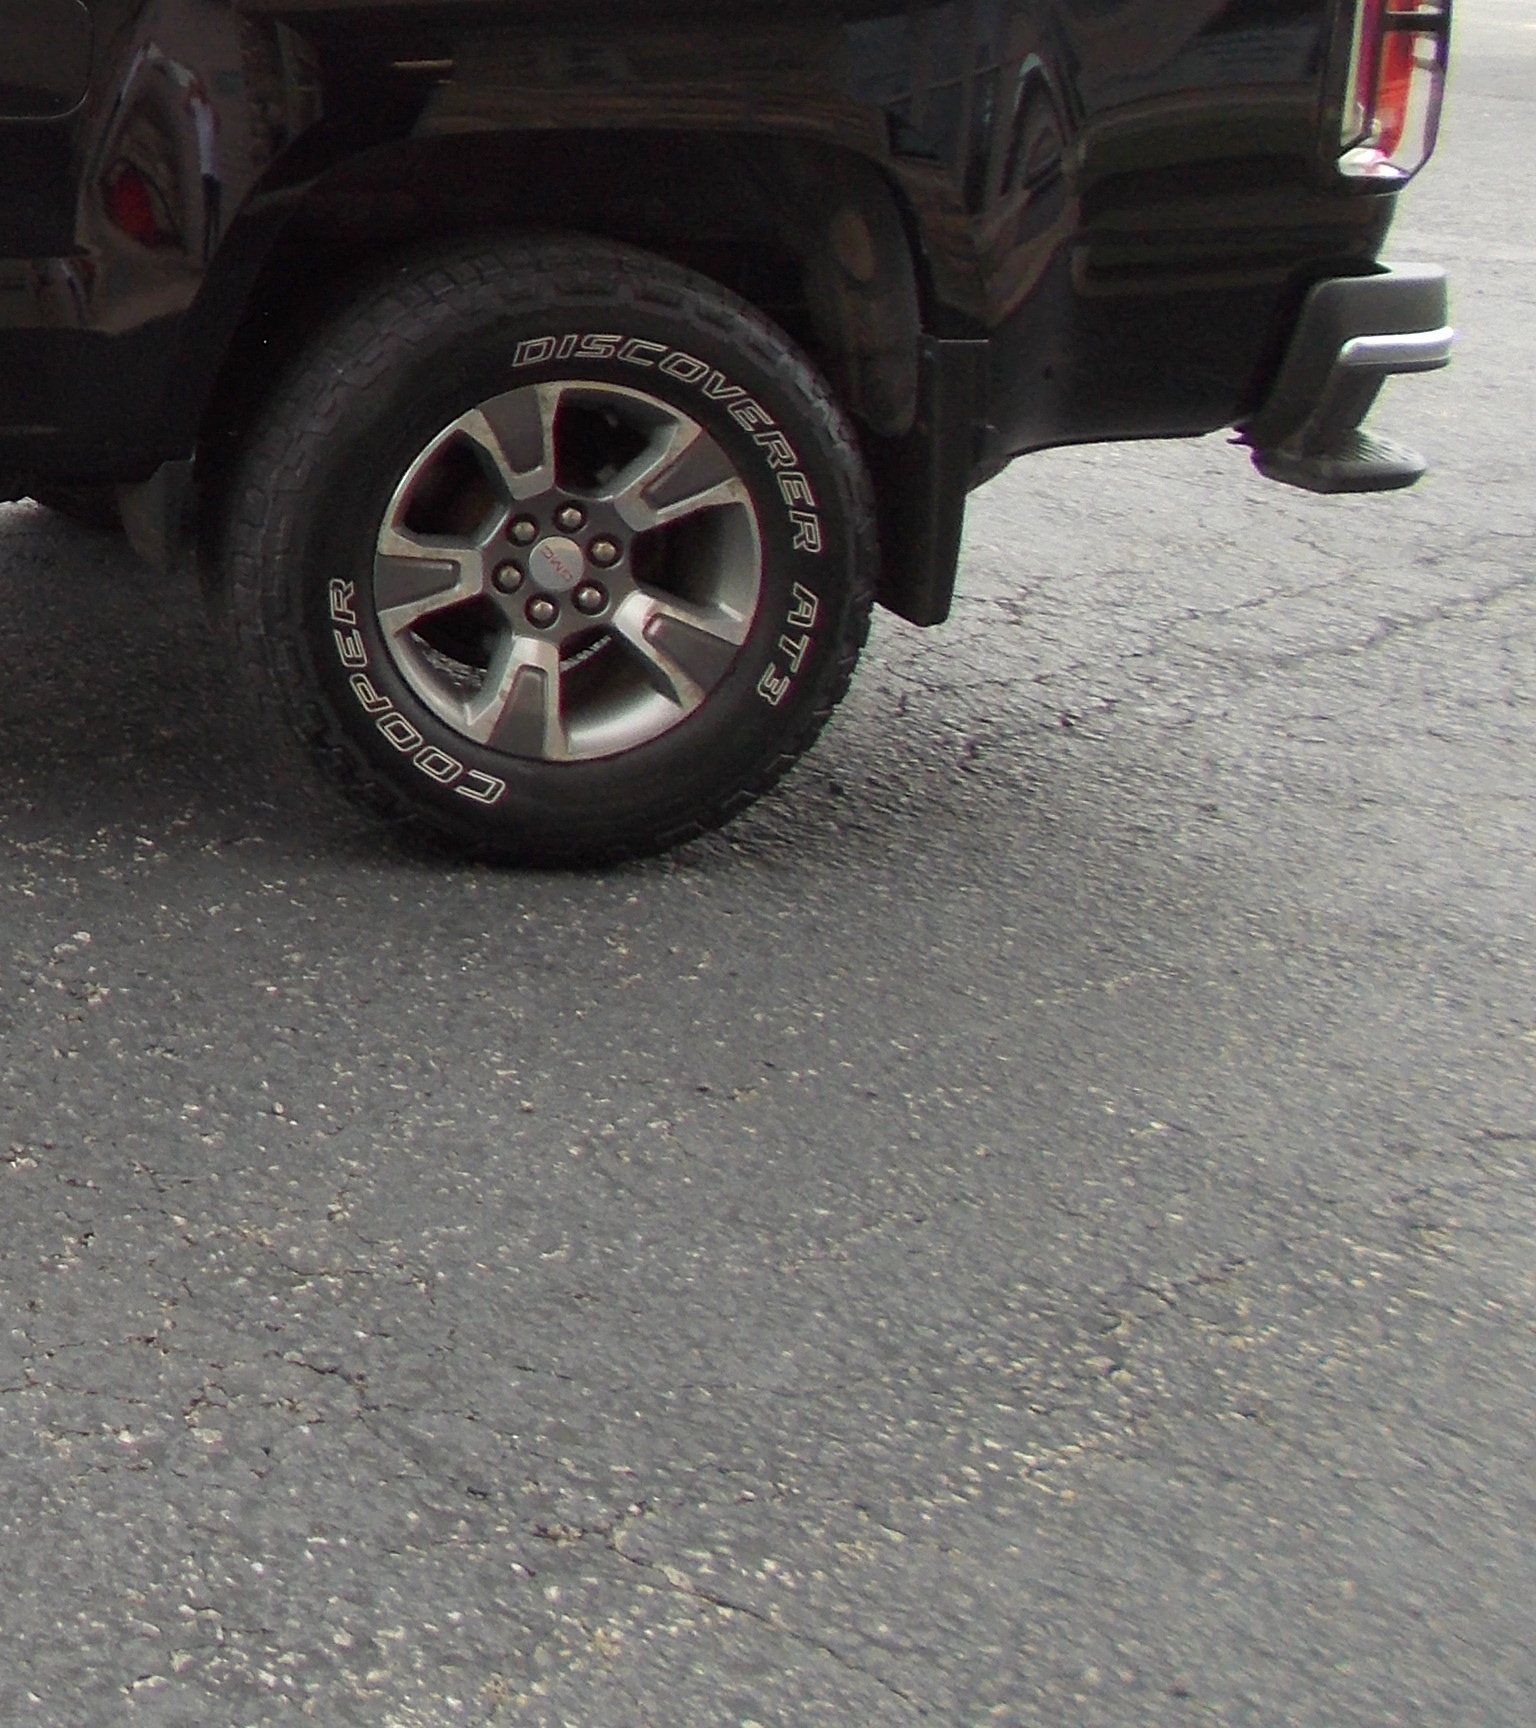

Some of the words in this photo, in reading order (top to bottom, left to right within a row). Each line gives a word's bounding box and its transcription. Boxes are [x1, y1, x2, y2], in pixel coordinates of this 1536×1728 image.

[511, 332, 823, 554] DISCOVERER
[755, 580, 820, 707] AT3
[327, 576, 506, 805] COOPER
